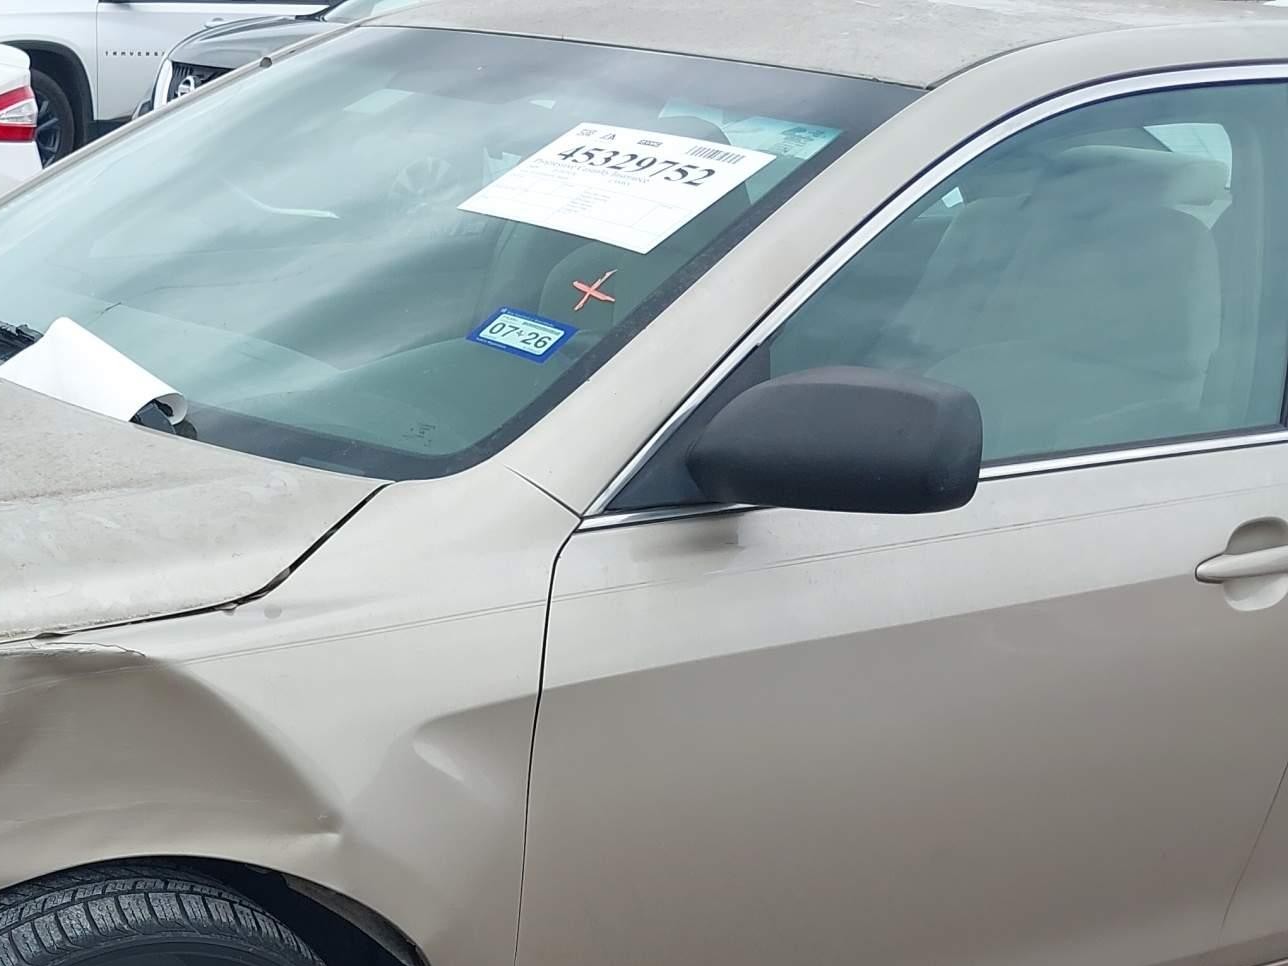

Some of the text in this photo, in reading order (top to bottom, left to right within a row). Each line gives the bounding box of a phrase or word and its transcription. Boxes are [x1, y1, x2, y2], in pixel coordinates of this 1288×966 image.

[557, 145, 715, 187] 45329752
[488, 322, 519, 337] 07
[520, 331, 552, 349] 26
